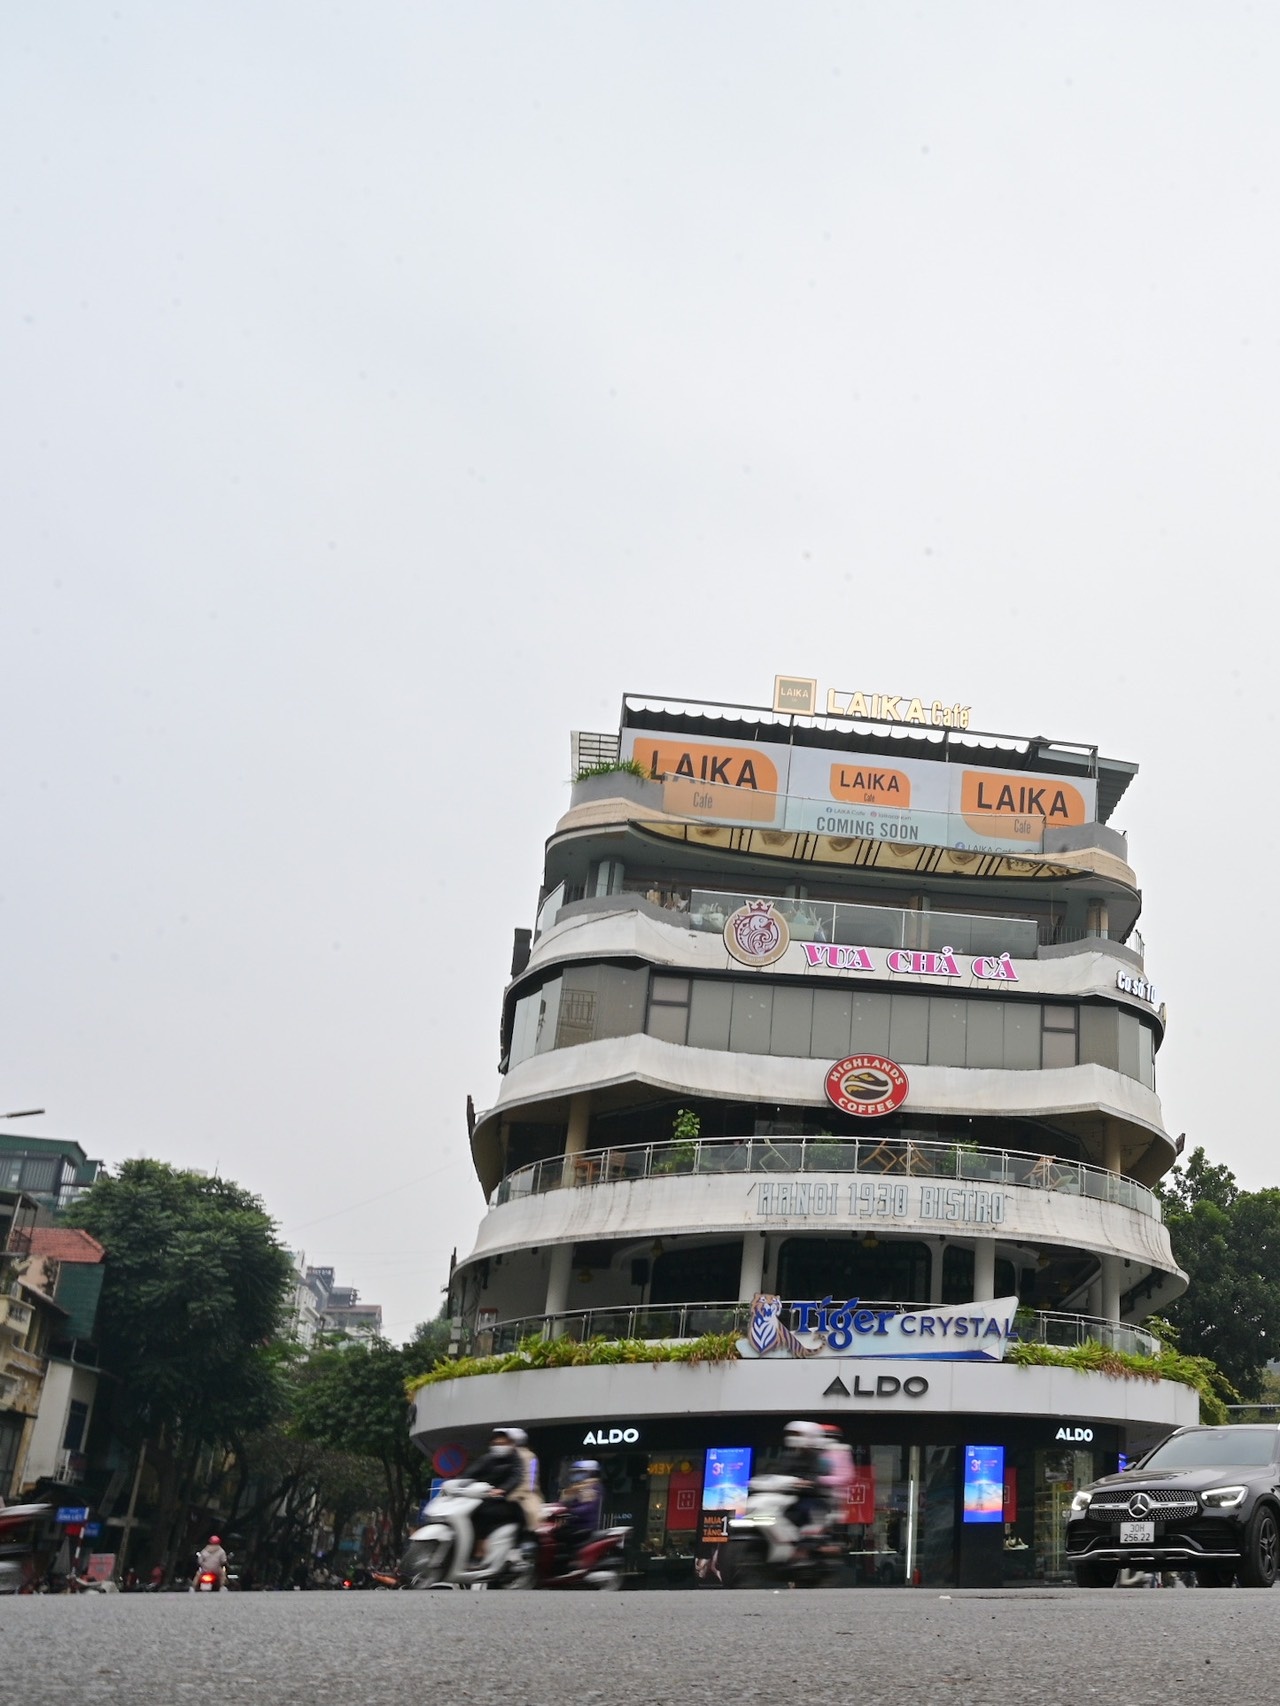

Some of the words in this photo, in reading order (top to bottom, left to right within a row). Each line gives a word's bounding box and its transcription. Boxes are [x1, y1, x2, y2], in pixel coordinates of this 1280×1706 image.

[780, 687, 809, 698] LAIKA
[826, 687, 927, 724] LAIKA
[931, 700, 973, 729] Café
[650, 750, 758, 790] LAIKA
[840, 770, 900, 792] LAIKA
[977, 781, 1069, 818] LAIKA
[816, 816, 874, 836] COMING
[880, 822, 919, 840] SOON
[802, 943, 875, 971] VUA
[887, 946, 962, 977] CHẢ
[971, 952, 1019, 982] CÁ
[830, 1058, 904, 1086] HIGHLANDS
[838, 1097, 896, 1114] COFFEE
[757, 1182, 838, 1216] HANOI
[848, 1182, 909, 1218] 1930
[920, 1185, 1005, 1224] BISTRO
[791, 1294, 898, 1351] Tiger
[901, 1315, 1020, 1339] CRYSTAL
[822, 1375, 930, 1398] ALDO
[583, 1428, 640, 1445] ALDO
[1055, 1427, 1094, 1442] ALDO
[1123, 1533, 1151, 1542] 256.22
[1130, 1523, 1145, 1532] 30H
